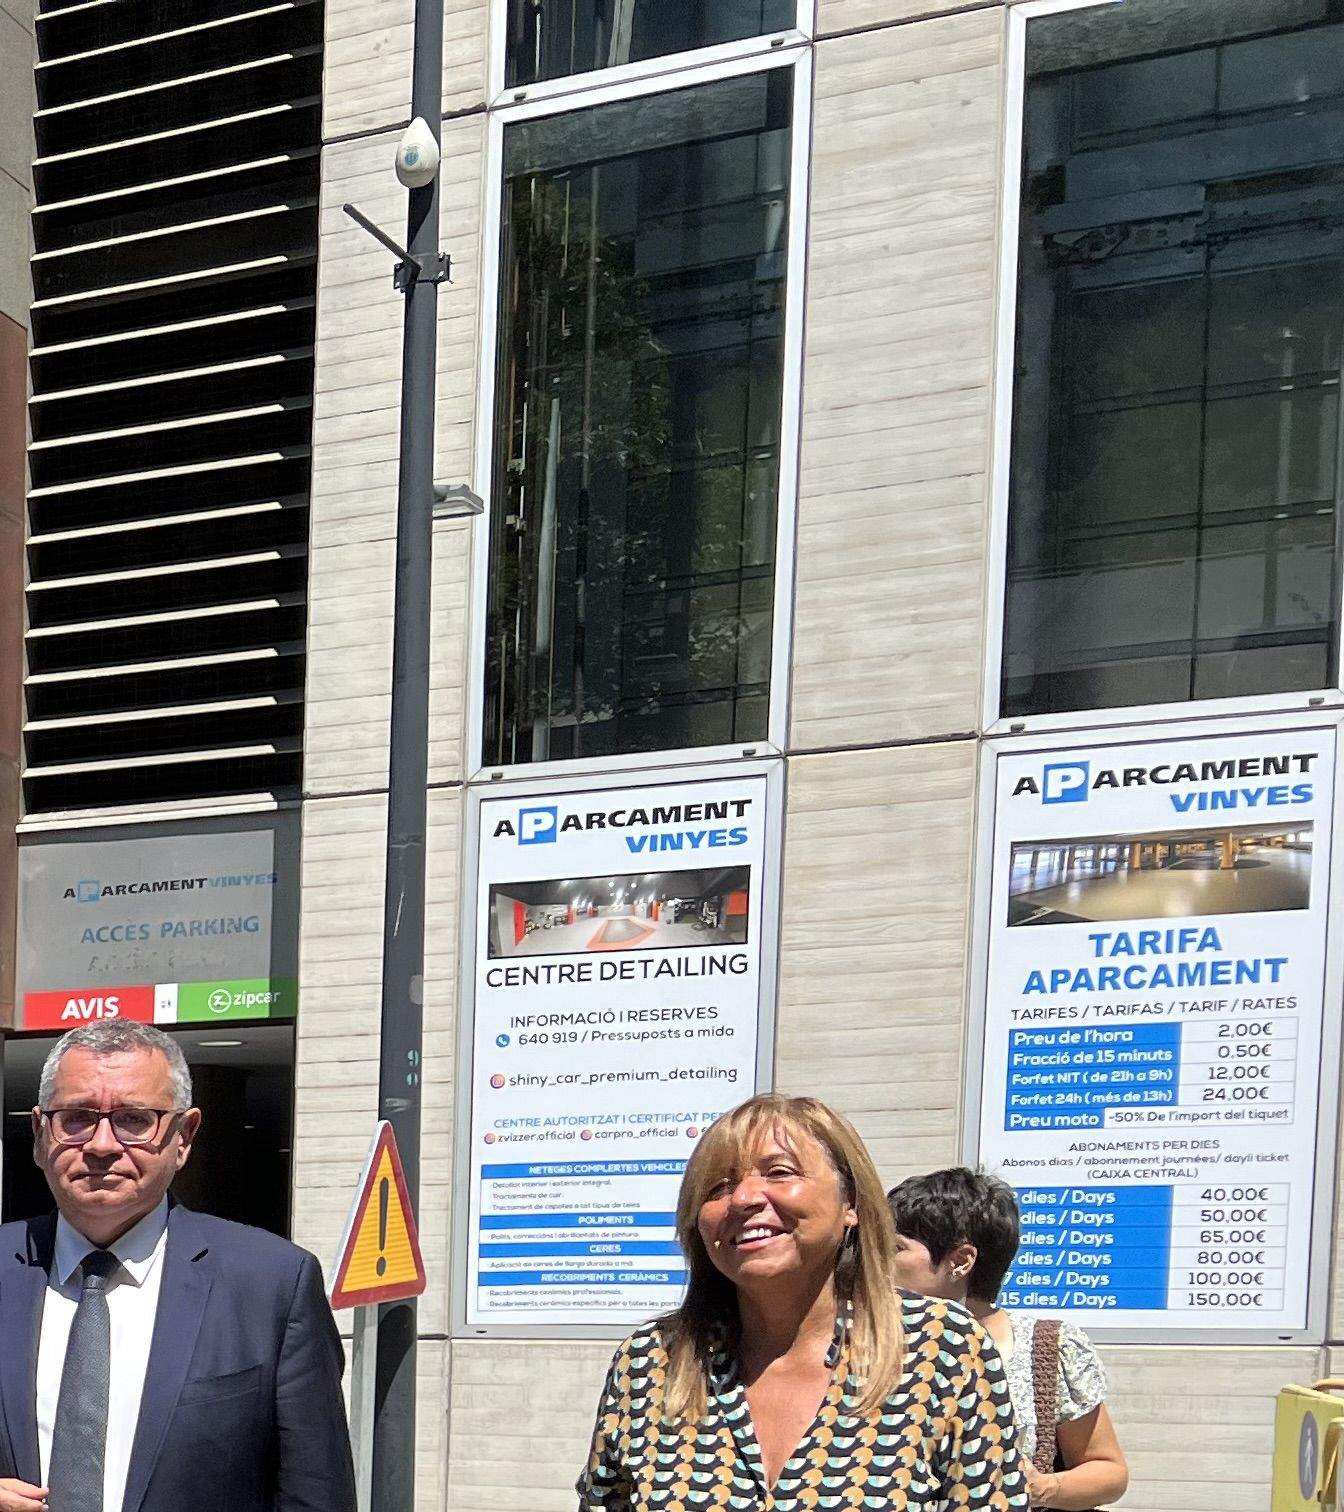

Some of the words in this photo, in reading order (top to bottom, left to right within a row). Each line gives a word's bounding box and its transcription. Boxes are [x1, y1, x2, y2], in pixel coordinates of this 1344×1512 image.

[1170, 783, 1314, 813] VINYES
[625, 827, 748, 853] VINYES
[161, 916, 259, 938] PARKING
[1089, 926, 1222, 957] TARIFA
[486, 962, 593, 987] CENTRE
[600, 954, 748, 981] DETAILING
[1022, 957, 1288, 995] APARCAMENT
[234, 990, 281, 1007] zipcar
[61, 997, 119, 1020] AVIS
[511, 1008, 615, 1028] INFORMACIÓ
[627, 1006, 718, 1023] RESERVES
[1011, 1007, 1078, 1020] TARIFES
[1095, 1002, 1163, 1017] TARIFAS
[1179, 1000, 1229, 1013] TARIF
[1242, 997, 1297, 1010] RATES
[518, 1032, 550, 1045] 640
[552, 1031, 577, 1043] 919
[591, 1028, 680, 1044] Pressuposts
[685, 1029, 694, 1038] a
[697, 1025, 734, 1037] mida
[1014, 1032, 1055, 1046] Preu
[1059, 1030, 1081, 1043] de
[1014, 1052, 1071, 1066] Fracció
[1073, 1051, 1094, 1064] de
[1096, 1050, 1115, 1063] 15
[1118, 1049, 1173, 1062] minuts
[509, 1067, 738, 1087] shiny_car_premium_detailing
[1012, 1073, 1054, 1085] Forfet
[1057, 1072, 1080, 1083] NIT
[1111, 1070, 1134, 1082] 21h
[1136, 1072, 1146, 1081] a
[1149, 1069, 1173, 1081] 9h)
[1011, 1094, 1052, 1106] Forfet
[1055, 1093, 1082, 1105] 24h
[1123, 1091, 1141, 1102] de
[1144, 1089, 1173, 1102] 13h)
[494, 1117, 541, 1128] CENTRE
[543, 1114, 619, 1127] AUTORITZAT
[629, 1112, 699, 1124] CERTIFICAT
[1010, 1114, 1051, 1127] Preu
[1054, 1114, 1099, 1126] moto
[1109, 1111, 1145, 1122] -50%
[1147, 1111, 1165, 1121] De
[1224, 1110, 1245, 1120] del
[1248, 1109, 1289, 1121] tiquet
[595, 1128, 678, 1140] carpro_official
[1069, 1141, 1160, 1151] ABONAMENTS
[1163, 1140, 1187, 1150] PER
[1190, 1139, 1220, 1149] DIES
[1002, 1158, 1046, 1166] Abonos
[1084, 1156, 1160, 1165] abonnement
[1256, 1153, 1289, 1163] ticket
[1087, 1169, 1131, 1179] (CAIXA
[1134, 1168, 1198, 1179] CENTRAL)
[1021, 1191, 1056, 1204] dies
[1072, 1190, 1115, 1206] Days
[1020, 1211, 1056, 1224] dies
[1072, 1210, 1114, 1226] Days
[1020, 1232, 1055, 1245] dies
[1070, 1231, 1113, 1247] Days
[1018, 1252, 1053, 1265] dies
[1068, 1251, 1112, 1268] Days
[1016, 1272, 1051, 1285] dies
[1066, 1272, 1109, 1288] Days
[1001, 1292, 1020, 1305] 15
[1023, 1292, 1058, 1305] dies
[1074, 1292, 1117, 1308] Days
